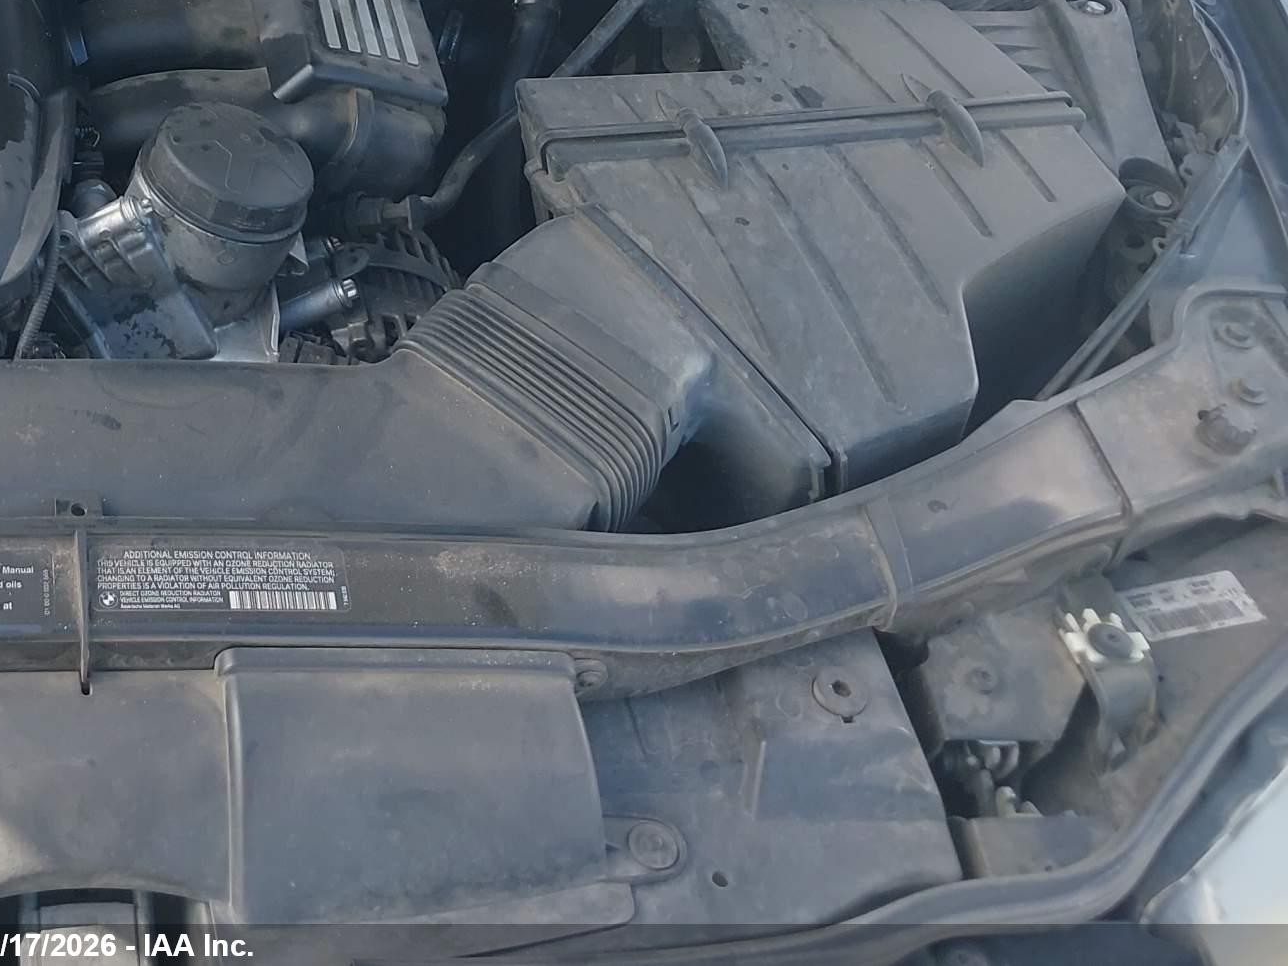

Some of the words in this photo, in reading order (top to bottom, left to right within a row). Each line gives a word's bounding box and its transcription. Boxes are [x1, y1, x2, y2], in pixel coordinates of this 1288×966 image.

[123, 550, 172, 559] ADDITIONAL
[174, 550, 213, 559] EMISSION
[214, 550, 253, 560] CONTROL
[254, 551, 311, 561] INFORMATION
[97, 559, 113, 567] THIS
[114, 559, 145, 567] VEHICLE
[146, 559, 154, 567] IS
[155, 559, 192, 567] EQUIPPED
[192, 559, 212, 567] WITH
[213, 559, 224, 567] AN
[225, 559, 251, 568] OZONE
[252, 560, 294, 568] REDUCTION
[296, 560, 334, 569] RADIATOR
[2, 566, 34, 575] Manual
[200, 567, 230, 575] VEHICLE
[231, 567, 266, 575] EMISSION
[268, 568, 302, 576] CONTROL
[97, 574, 135, 582] CHANGING
[136, 574, 146, 582] TO
[153, 574, 189, 582] RADIATOR
[190, 574, 222, 582] WITHOUT
[224, 575, 267, 583] EQUIVALENT
[268, 575, 293, 583] OZONE
[294, 575, 334, 584] REDUCTION
[5, 580, 22, 588] oils
[157, 582, 195, 590] VIOLATION
[196, 582, 207, 590] OF
[208, 582, 220, 590] AIR
[221, 582, 261, 590] POLLUTION
[262, 583, 309, 591] REGULATION.
[3, 602, 13, 610] at
